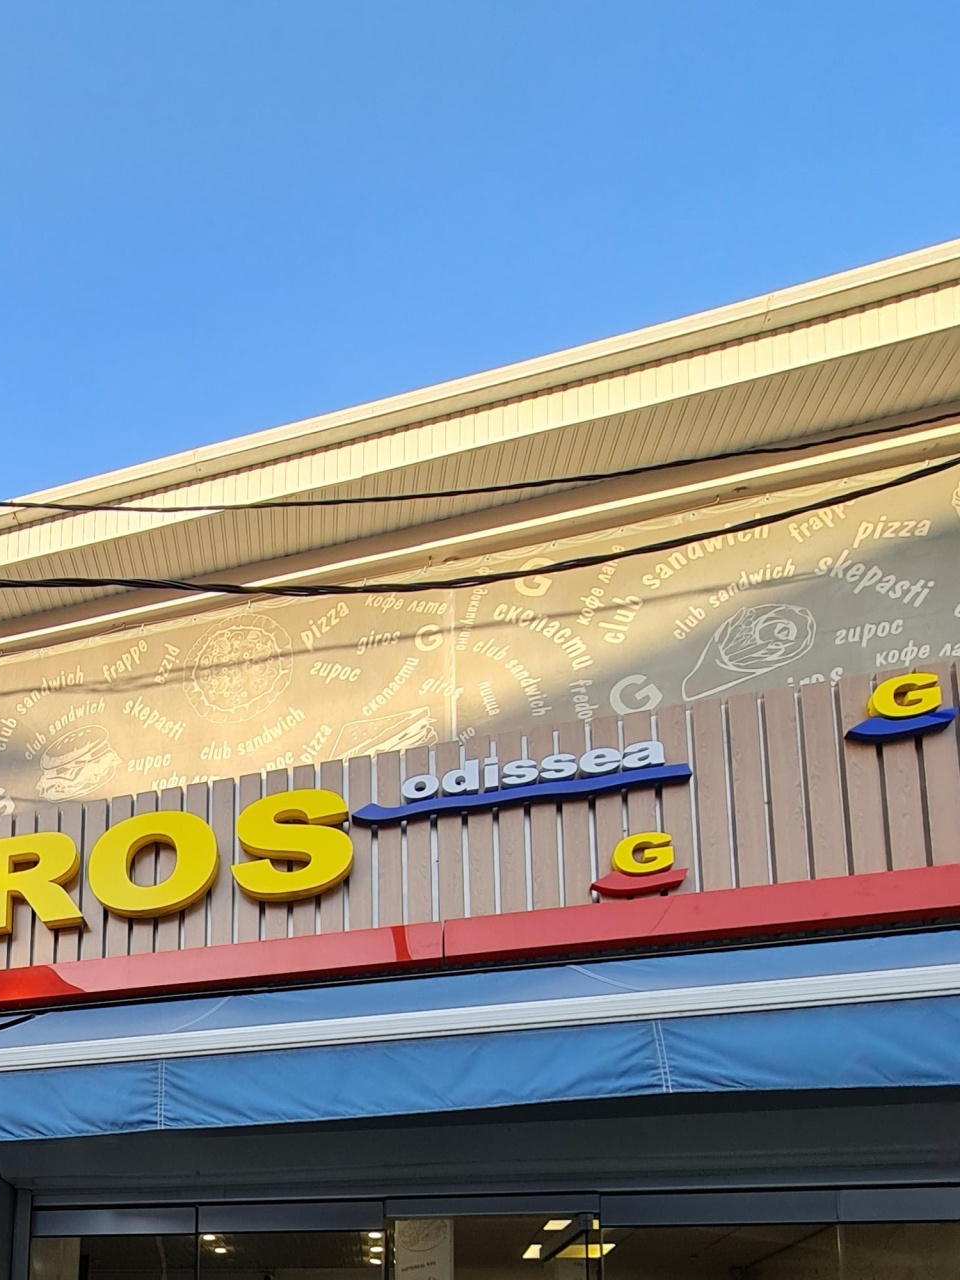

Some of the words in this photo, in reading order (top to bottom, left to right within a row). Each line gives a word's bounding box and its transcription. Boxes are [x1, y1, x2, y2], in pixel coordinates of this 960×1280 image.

[853, 515, 931, 549] pizza
[673, 606, 707, 640] club
[708, 558, 796, 609] sandwich
[814, 549, 935, 608] skepasti
[300, 600, 351, 649] pizza
[364, 591, 403, 615] кофе
[406, 598, 448, 615] лате
[576, 587, 605, 626] кофе
[598, 594, 644, 644] club
[356, 628, 400, 655] giros
[414, 624, 443, 652] G
[493, 602, 594, 671] скепасти
[834, 619, 904, 648] гирос
[876, 640, 930, 667] кофе
[103, 639, 148, 683] frappe
[154, 643, 181, 684] pizza
[310, 660, 362, 685] гирос
[472, 637, 510, 661] club
[505, 659, 553, 717] sandwich
[16, 665, 85, 715] sandwich
[362, 656, 420, 716] скепасти
[418, 676, 464, 701] giros
[477, 679, 501, 717] пицца
[609, 674, 663, 716] G
[867, 673, 943, 719] G
[24, 732, 47, 760] club
[48, 697, 105, 735] sandwich
[123, 696, 187, 741] skepasti
[200, 740, 232, 761] club
[237, 706, 306, 756] sandwich
[127, 753, 172, 776] гирос
[299, 723, 333, 764] pizza
[401, 740, 666, 805] odissea
[611, 832, 675, 877] G
